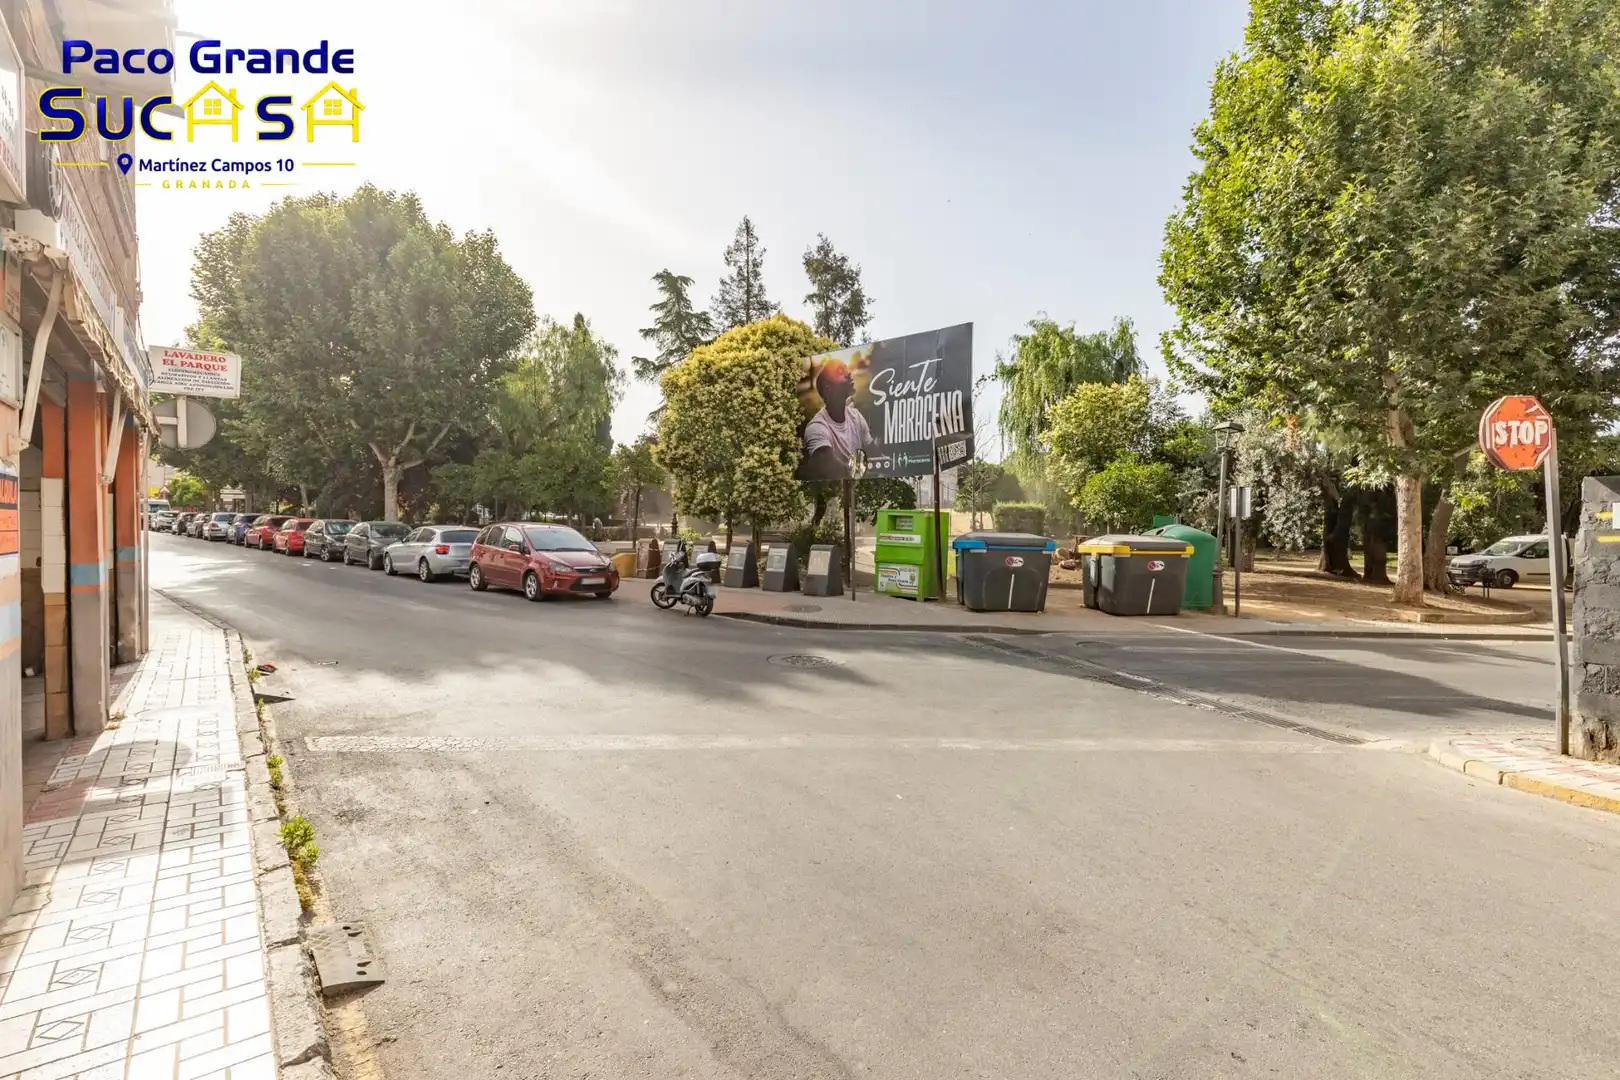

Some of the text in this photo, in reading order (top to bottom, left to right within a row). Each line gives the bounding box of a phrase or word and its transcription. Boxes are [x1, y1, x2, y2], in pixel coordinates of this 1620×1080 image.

[162, 358, 228, 372] EL PARQUE
[163, 350, 226, 363] LAVADERO
[884, 389, 964, 444] MARACENA
[1495, 420, 1548, 446] STOP
